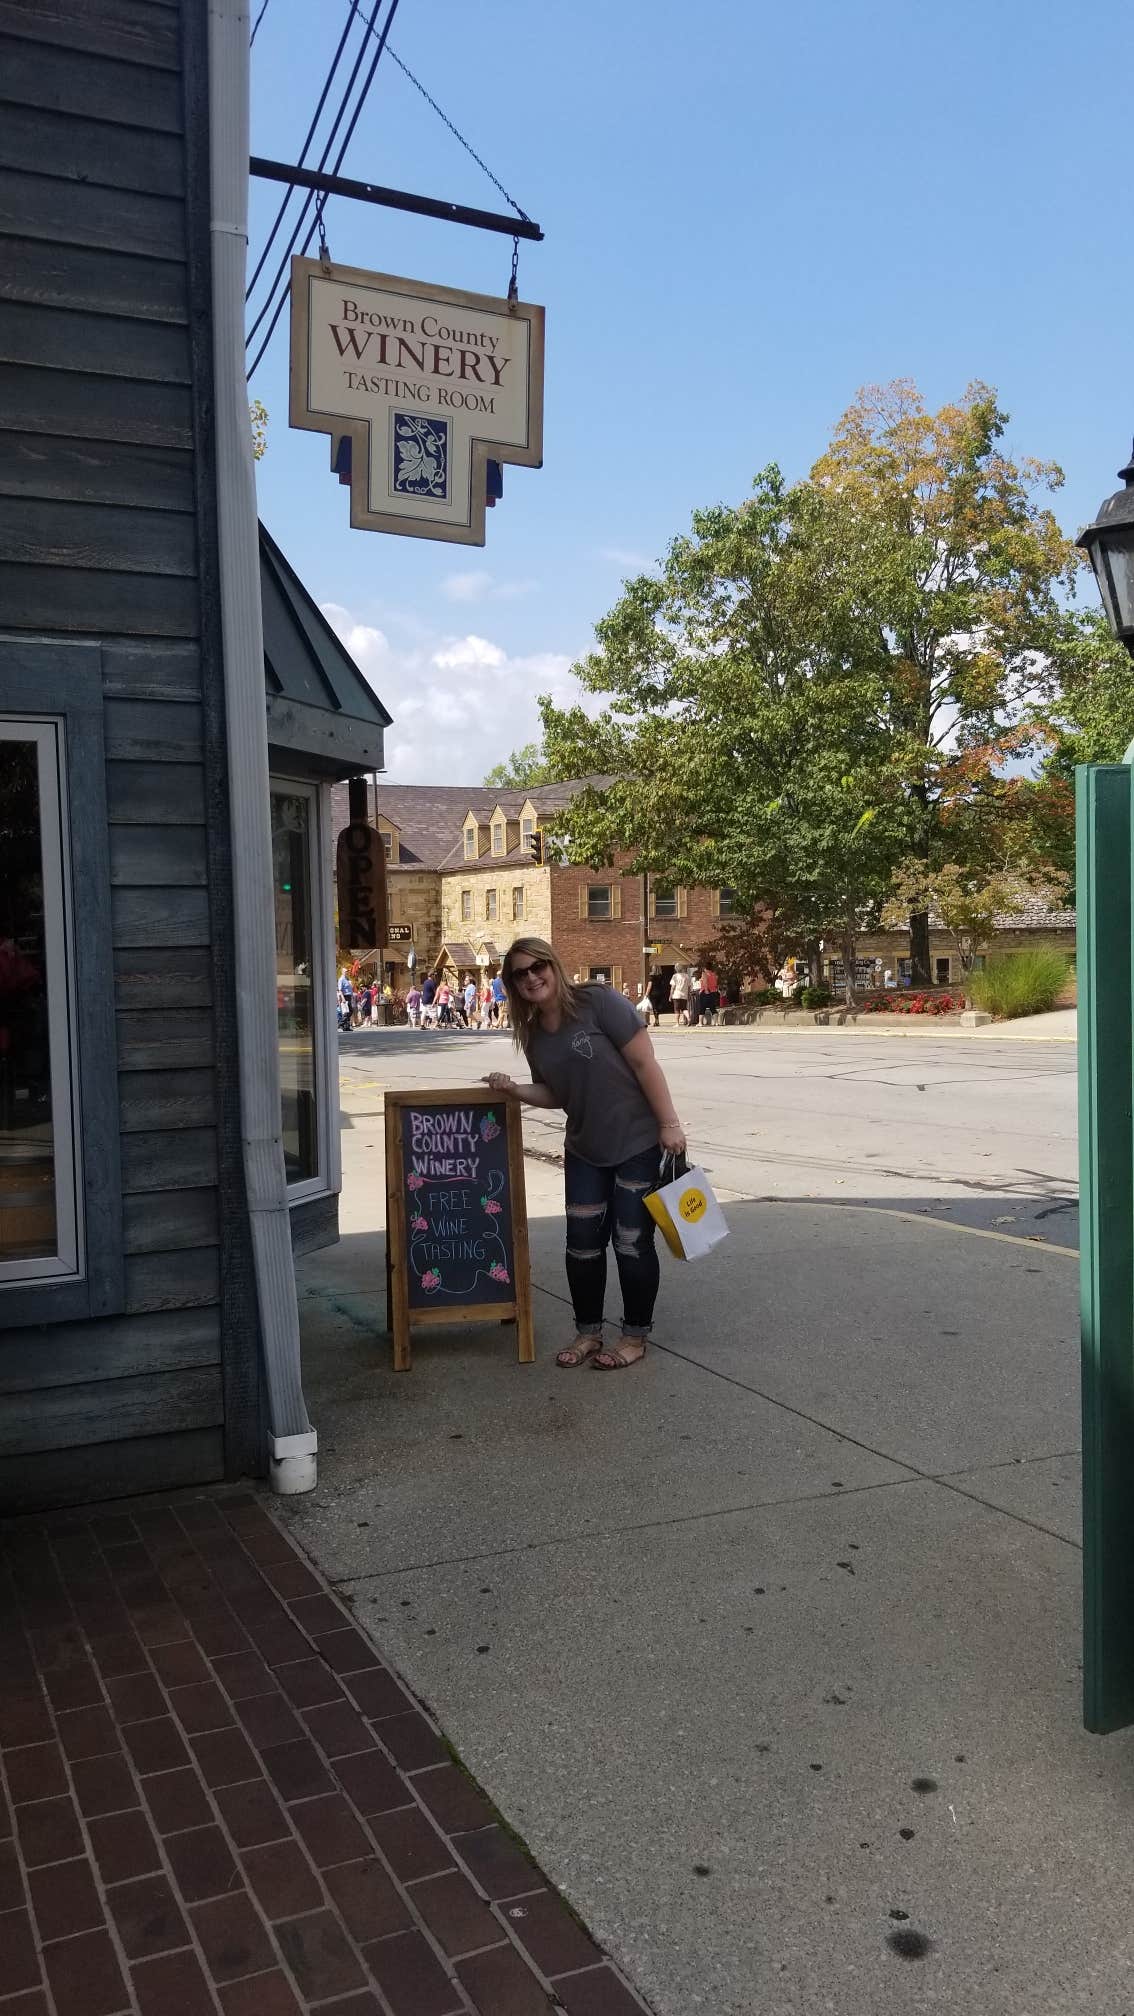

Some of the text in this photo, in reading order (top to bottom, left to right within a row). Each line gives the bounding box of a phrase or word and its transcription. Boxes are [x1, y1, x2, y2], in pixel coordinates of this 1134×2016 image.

[342, 299, 502, 353] Brown County
[328, 323, 512, 387] WINERY
[343, 371, 496, 414] TASTING ROOM
[410, 1110, 474, 1134] BROWN
[411, 1133, 479, 1153] COUNTY
[428, 1190, 473, 1211] FREE
[430, 1216, 470, 1238] WINE
[420, 1239, 487, 1261] TASTING
